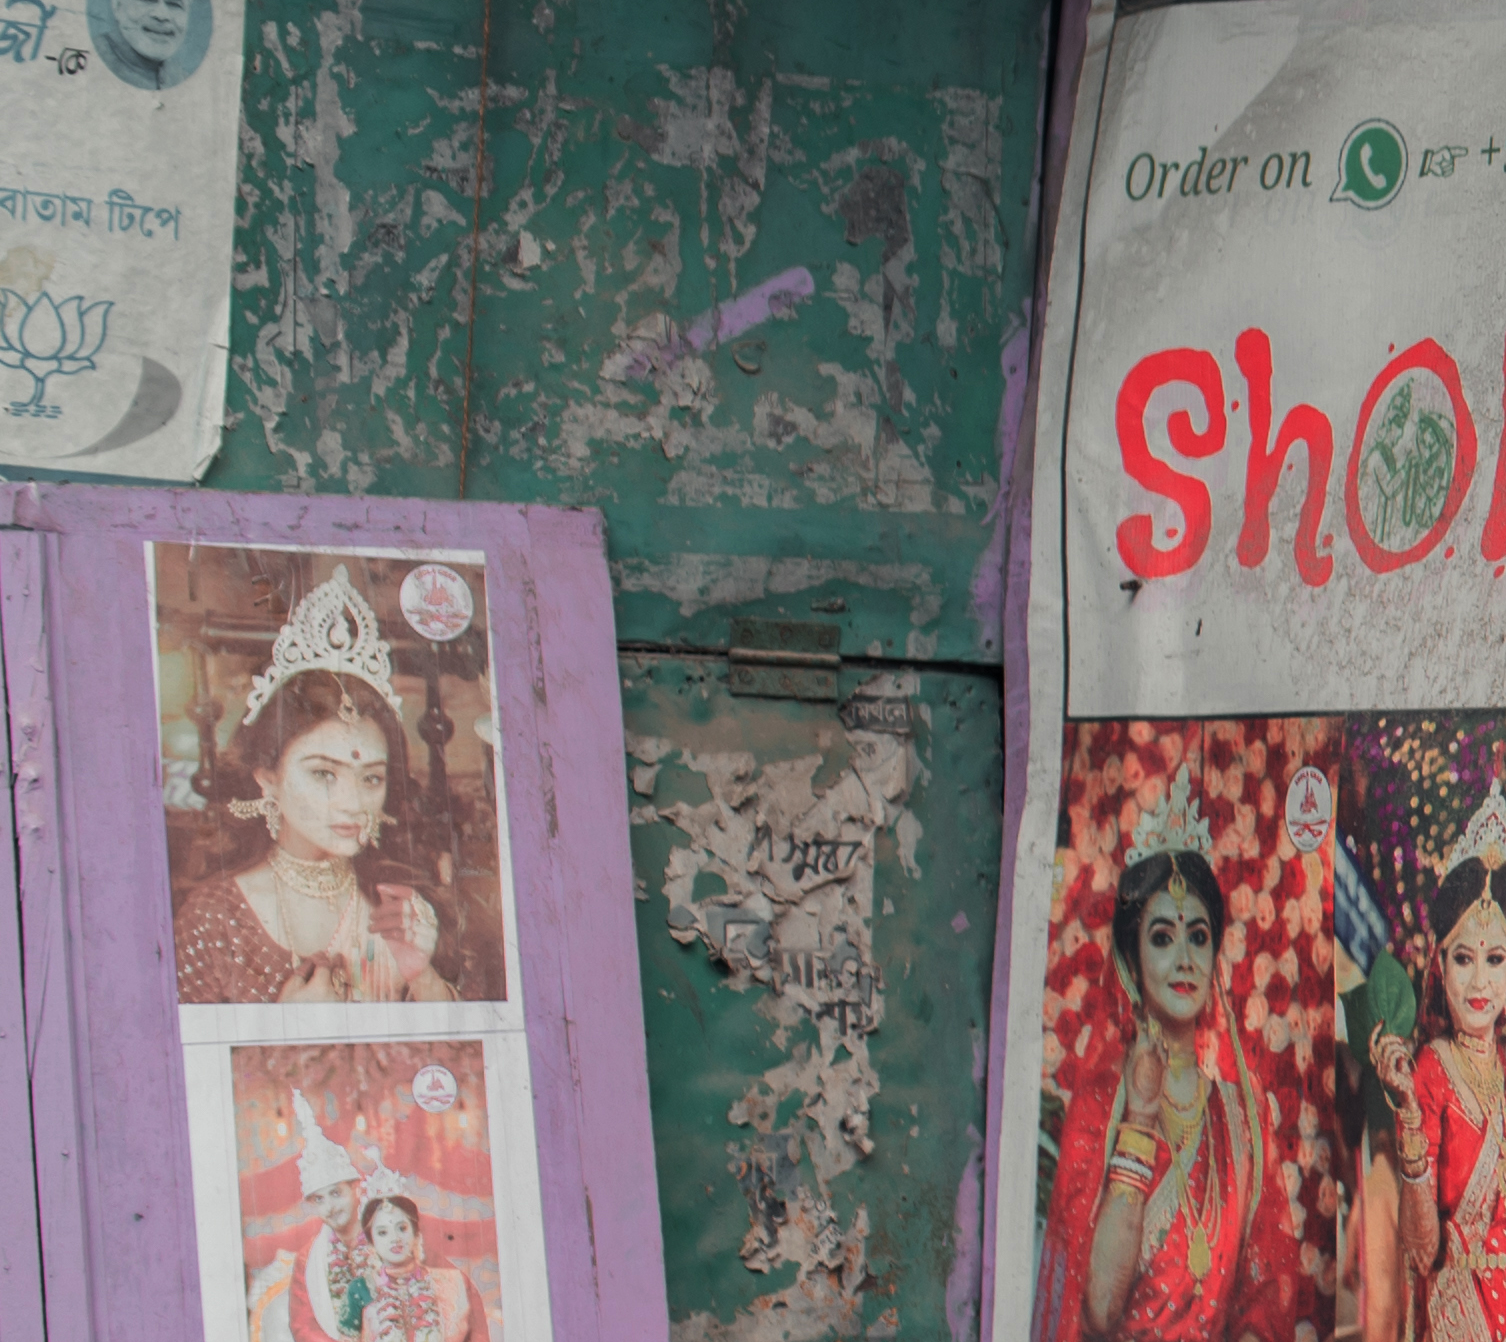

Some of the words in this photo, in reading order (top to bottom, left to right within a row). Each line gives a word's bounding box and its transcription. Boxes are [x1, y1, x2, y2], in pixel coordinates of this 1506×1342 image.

[1125, 146, 1249, 202] Order
[1259, 150, 1313, 191] on
[105, 187, 182, 242] টিপে
